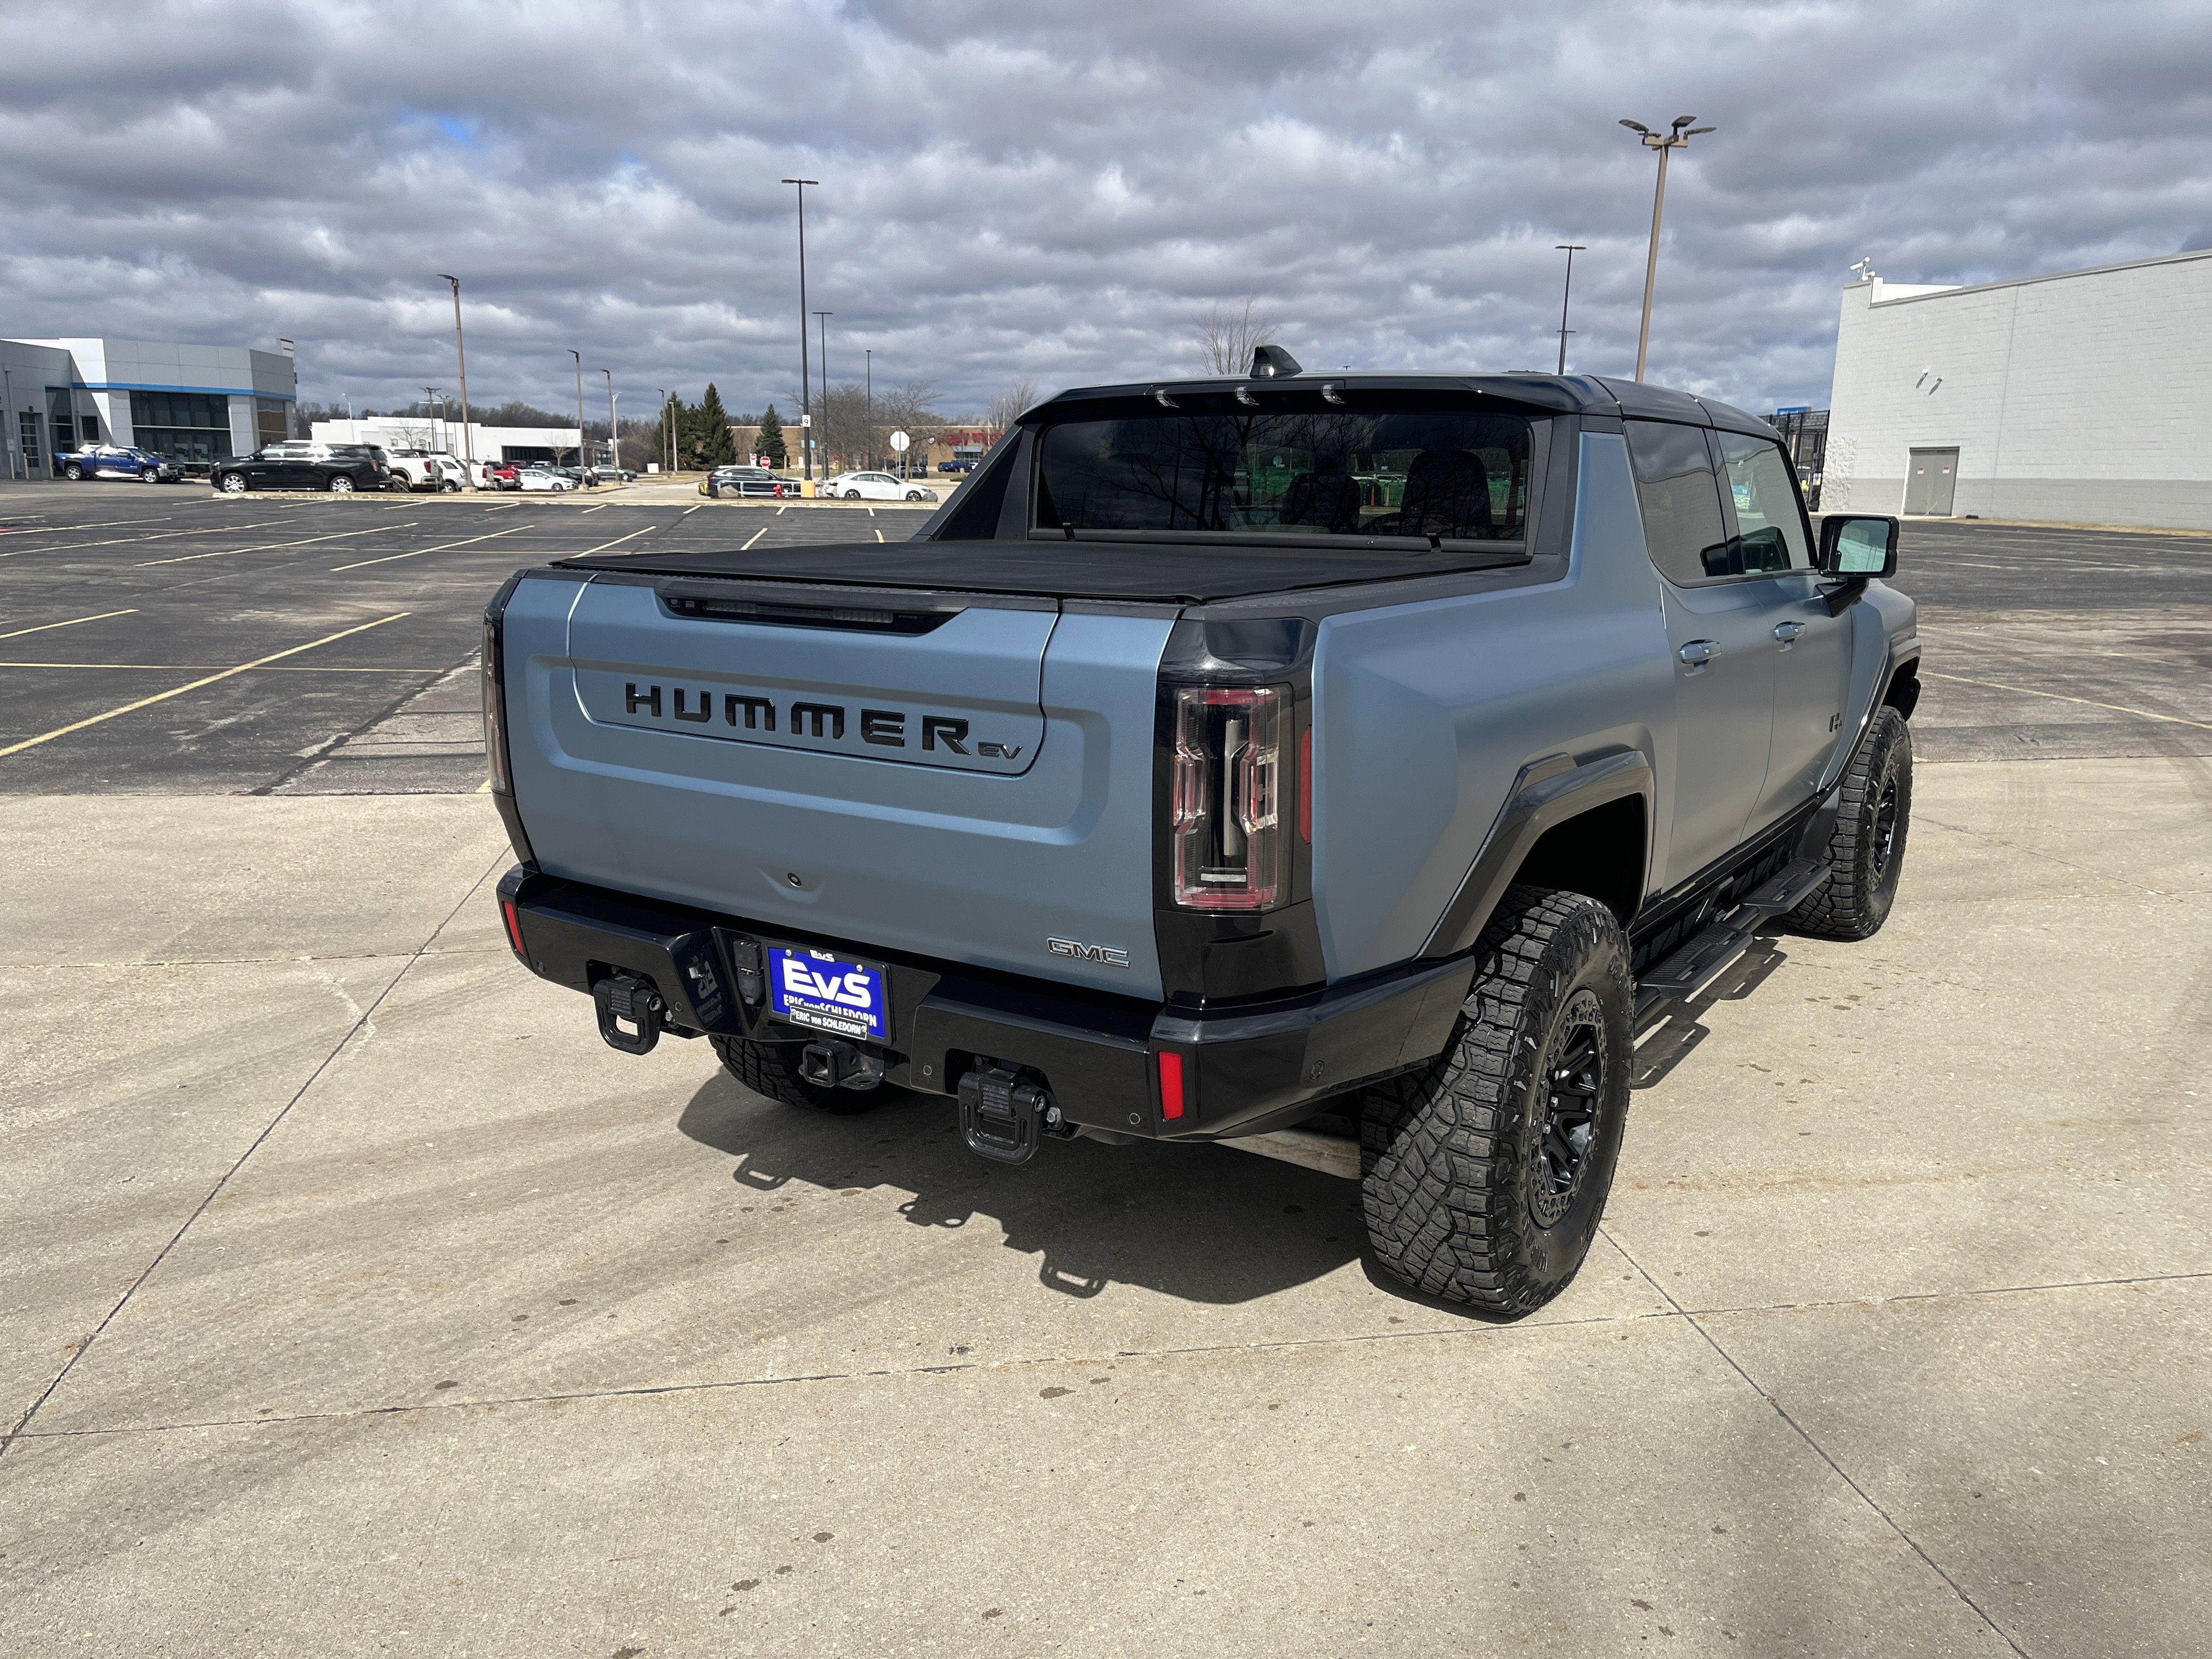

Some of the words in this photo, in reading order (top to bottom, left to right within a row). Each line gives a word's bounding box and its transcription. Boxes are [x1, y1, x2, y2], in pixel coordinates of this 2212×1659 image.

[625, 682, 972, 755] HUMMER
[978, 742, 1023, 759] EV
[1047, 936, 1130, 967] GMC
[795, 1011, 810, 1022] ERIC
[811, 1016, 822, 1025] von
[822, 1017, 861, 1035] SCHLEDORN
